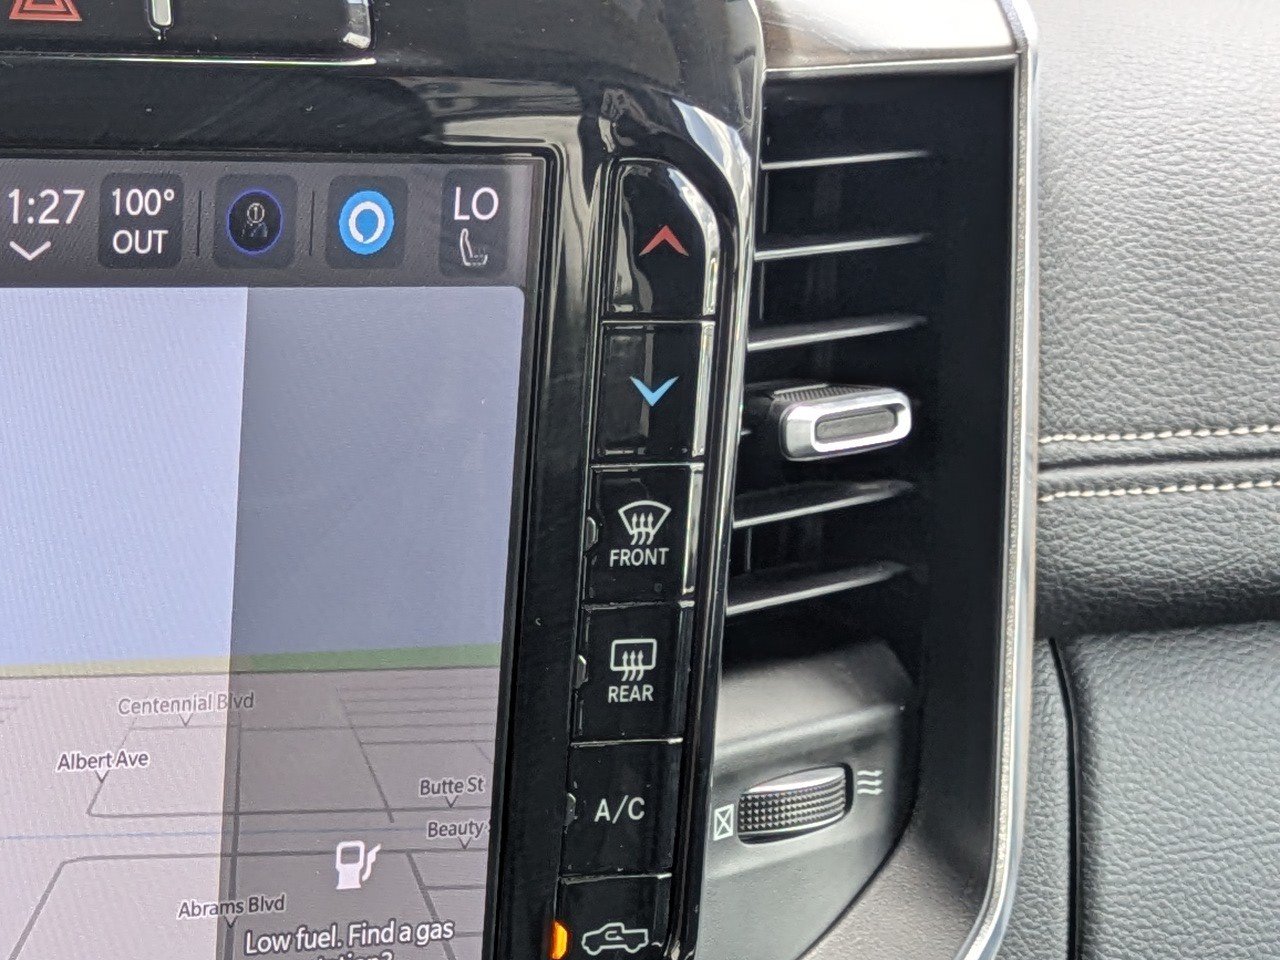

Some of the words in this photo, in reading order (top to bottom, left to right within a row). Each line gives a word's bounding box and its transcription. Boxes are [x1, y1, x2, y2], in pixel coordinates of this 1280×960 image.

[111, 187, 176, 217] 100°
[453, 186, 500, 222] LO
[112, 229, 169, 255] OUT
[609, 547, 669, 568] FRONT
[118, 695, 212, 716] Centennial
[218, 692, 255, 710] Blvd
[607, 685, 655, 704] REAR
[57, 752, 113, 772] Albert
[115, 751, 150, 769] Ave
[419, 779, 464, 796] Butte
[467, 776, 484, 793] St
[594, 795, 646, 824] A/C
[427, 820, 484, 839] Beauty
[178, 898, 244, 919] Abrams
[248, 894, 286, 913] Blvd
[245, 930, 290, 954] Low
[295, 924, 342, 950] fuel.
[349, 920, 395, 945] Find
[399, 926, 412, 943] a
[415, 921, 455, 947] gas
